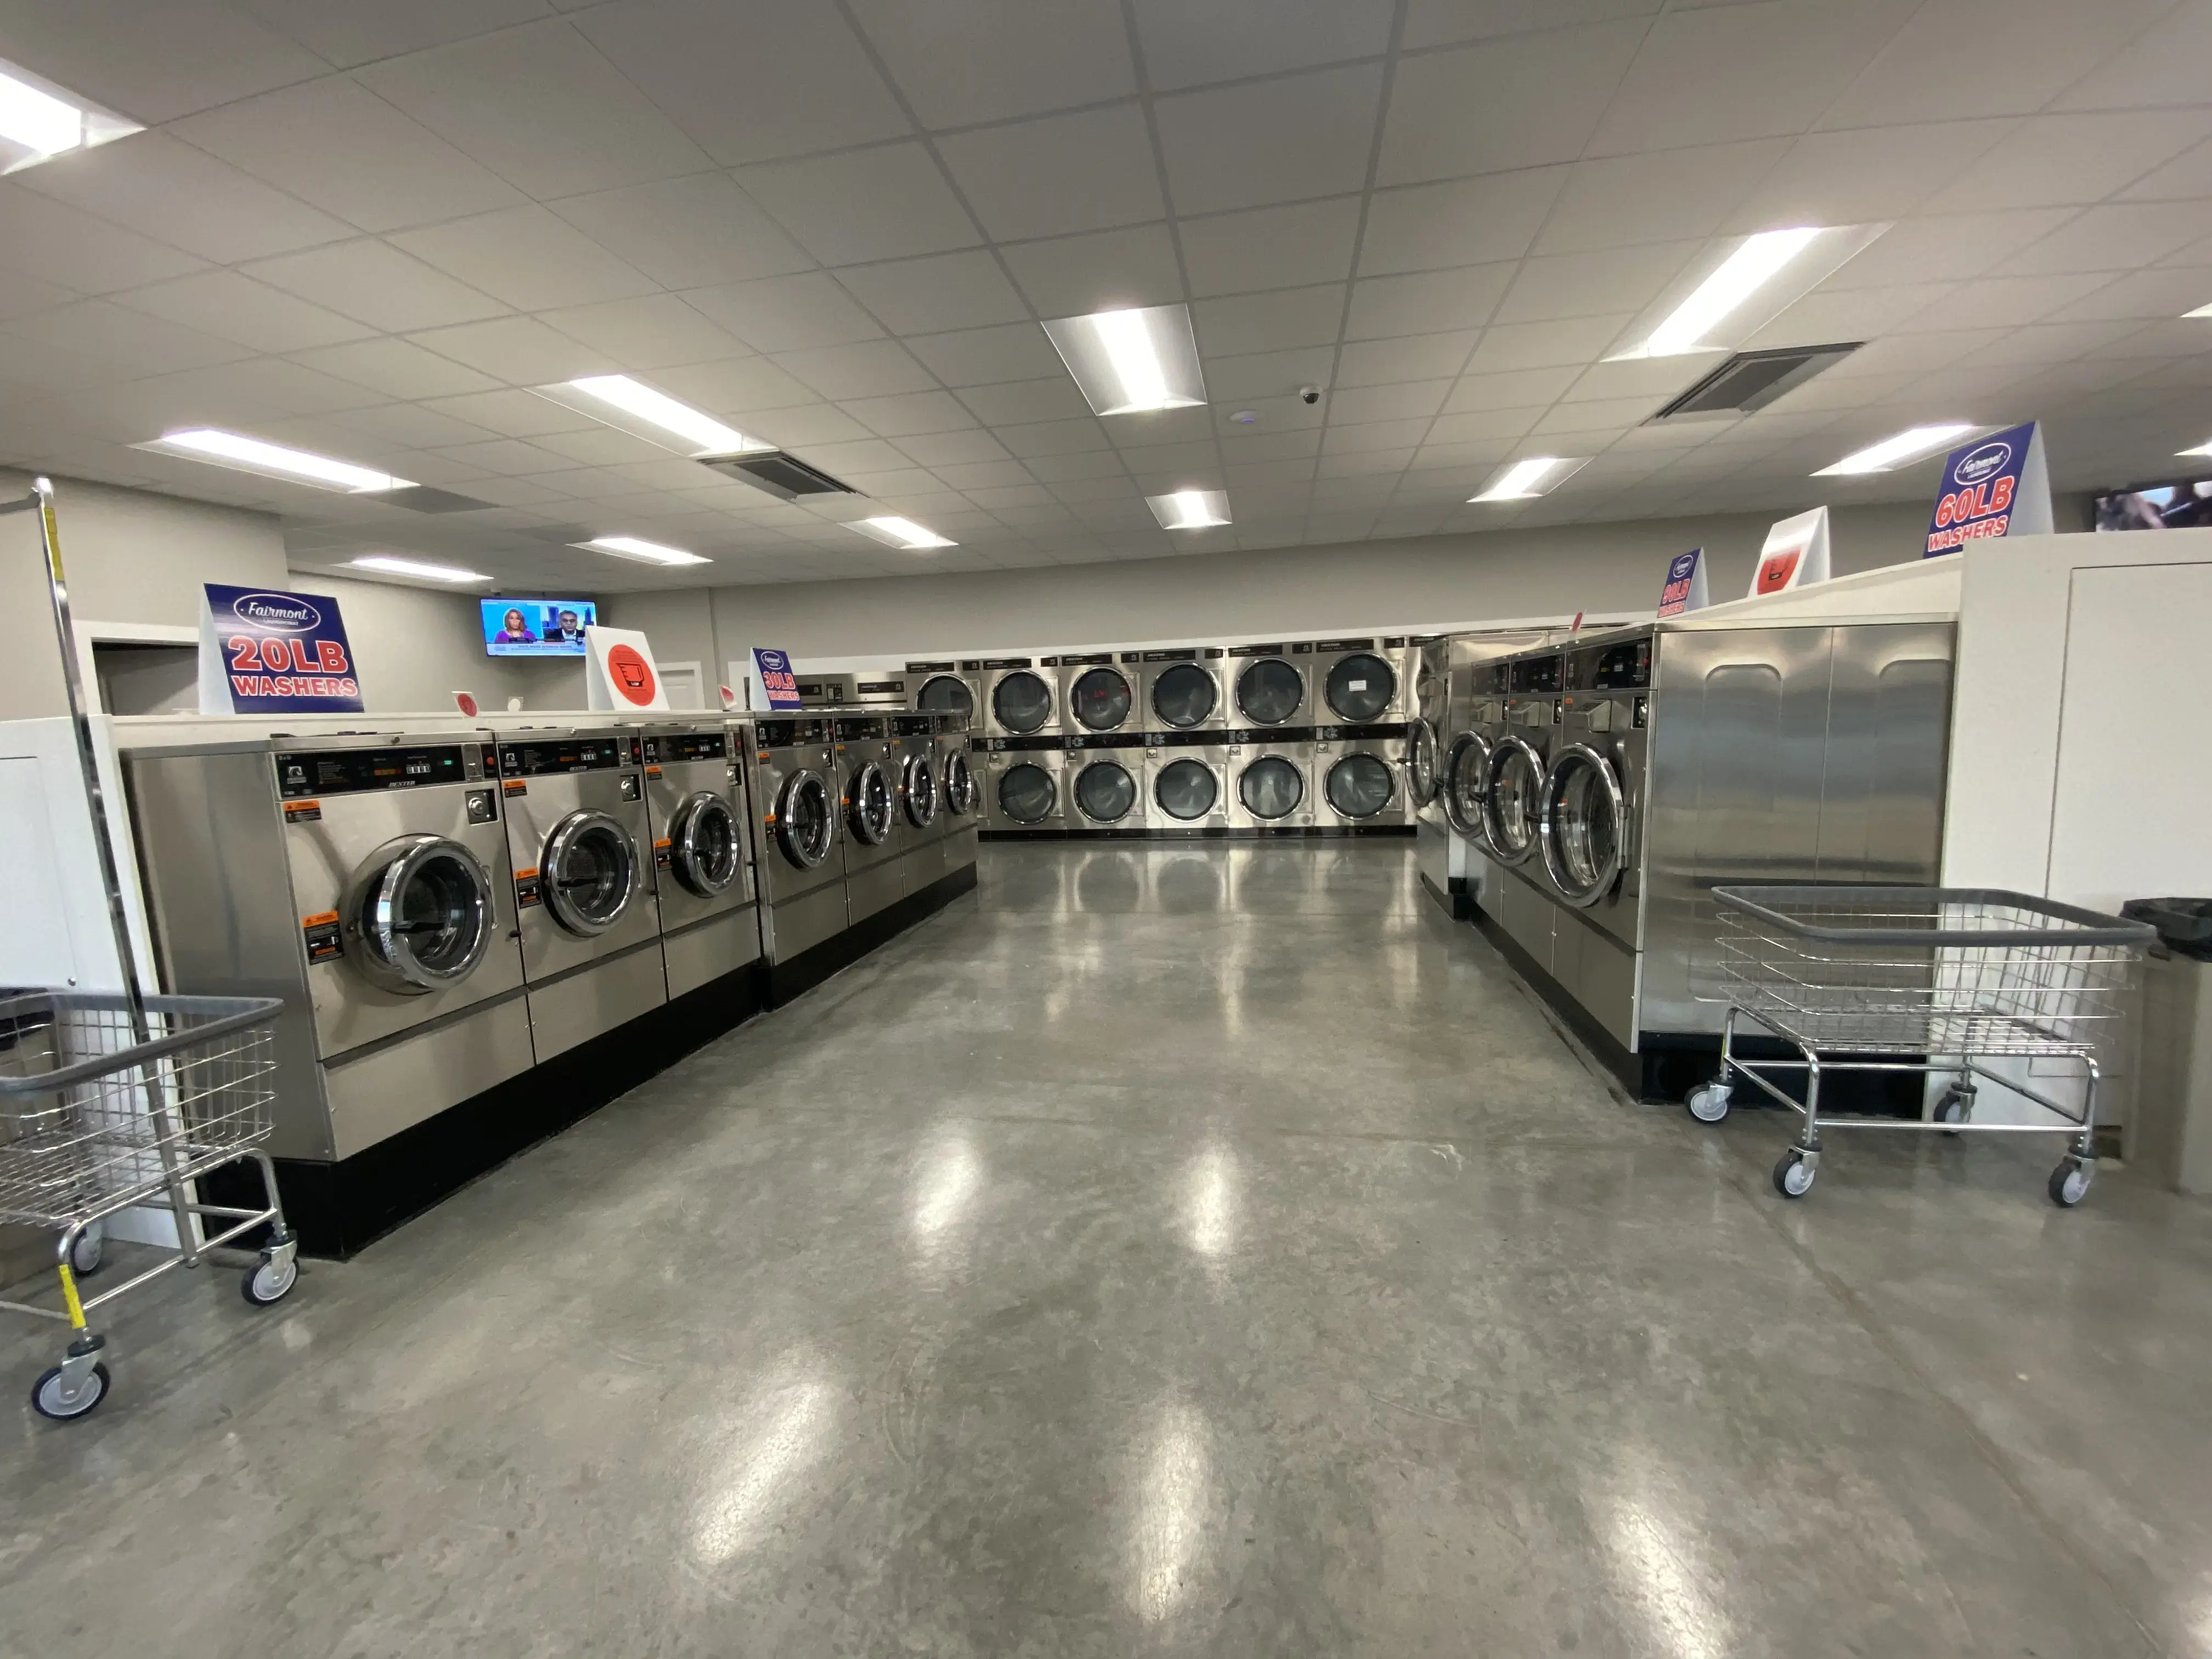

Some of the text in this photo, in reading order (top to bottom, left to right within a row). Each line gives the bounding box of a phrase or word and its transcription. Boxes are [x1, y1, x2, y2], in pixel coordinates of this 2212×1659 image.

[1936, 475, 2015, 528] 60LB
[1927, 515, 2008, 552] WASHERS
[248, 602, 308, 620] Fairmont
[228, 635, 348, 673] 20LB
[231, 675, 358, 697] WASHERS
[763, 671, 796, 690] 30LB
[767, 690, 800, 701] WASHERS
